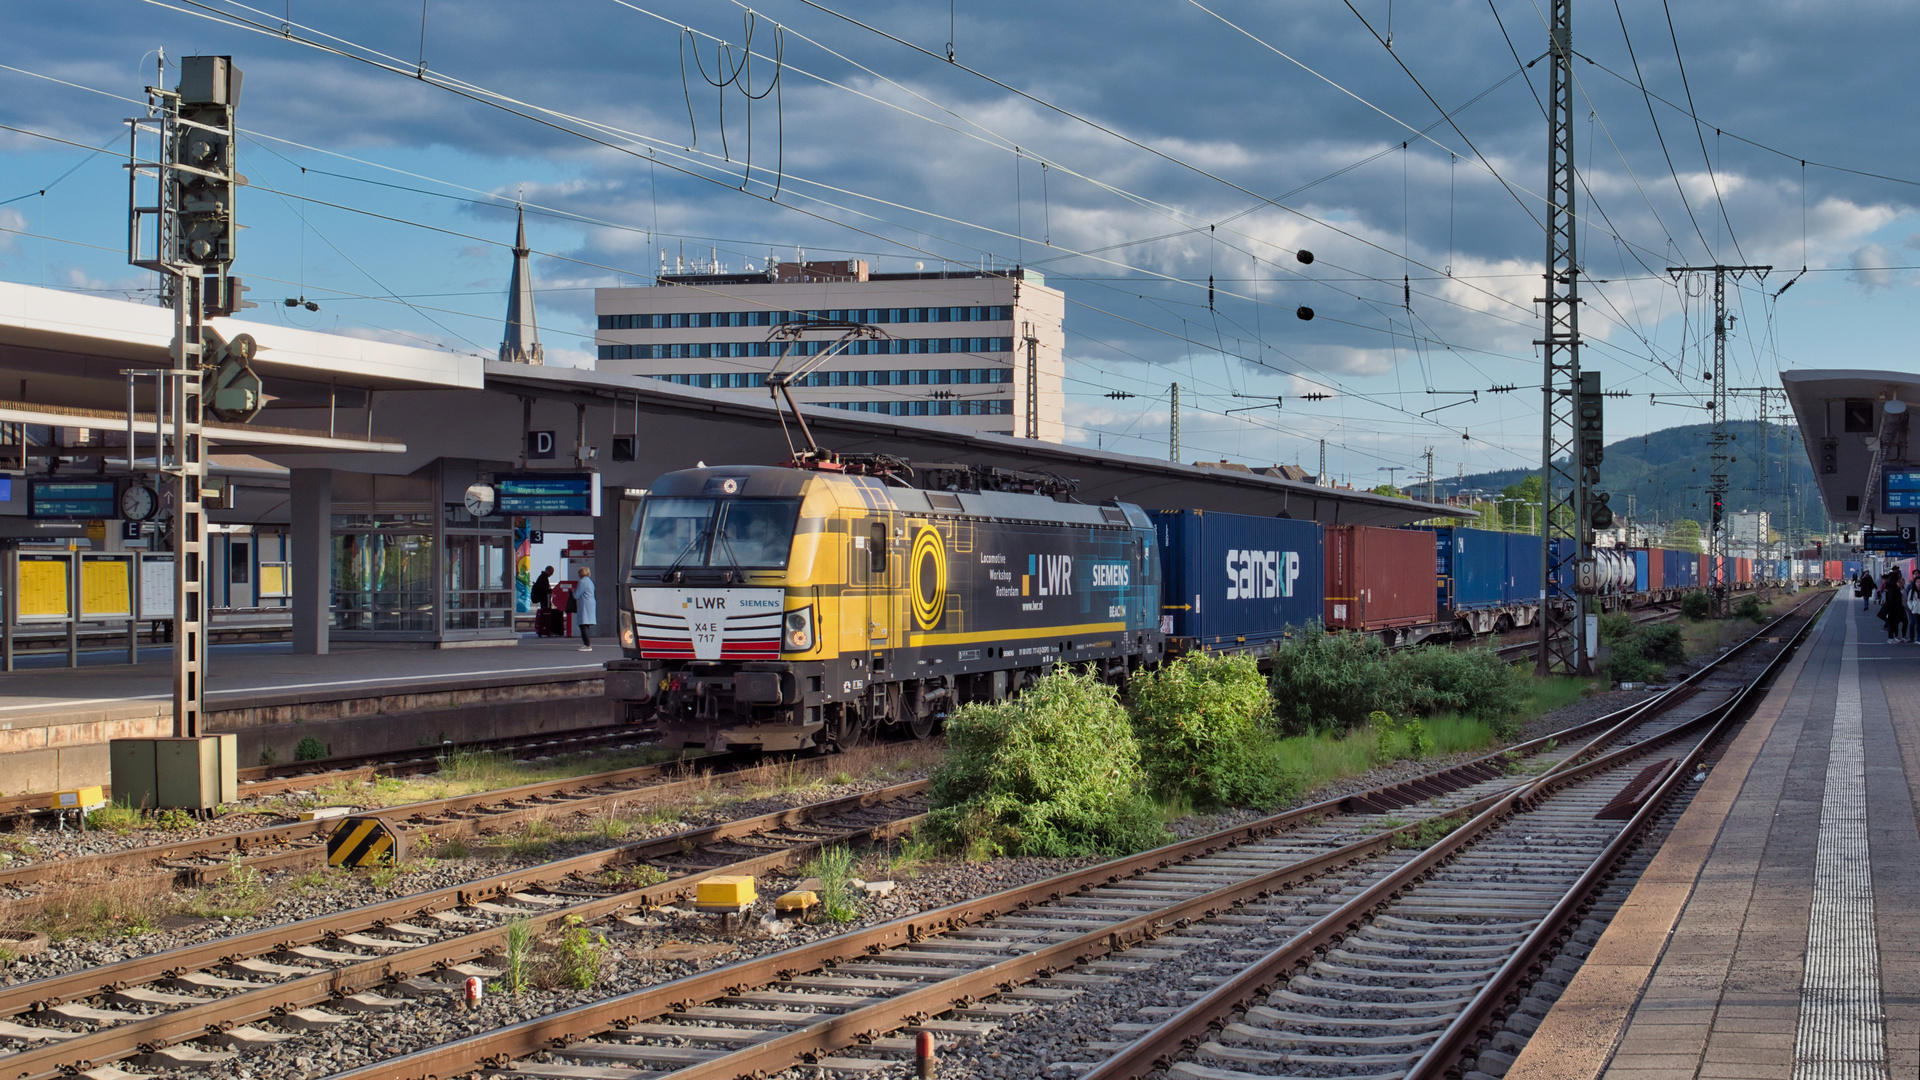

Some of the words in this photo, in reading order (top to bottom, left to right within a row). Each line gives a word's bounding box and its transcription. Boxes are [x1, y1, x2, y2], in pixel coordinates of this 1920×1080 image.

[537, 432, 552, 453] D
[129, 522, 137, 536] E
[1902, 528, 1910, 539] 8
[535, 531, 541, 541] 3
[980, 552, 1006, 564] Locomotive
[990, 569, 1011, 582] Workshop
[1038, 554, 1072, 596] LWR
[1092, 564, 1128, 586] SIEMENS
[996, 586, 1019, 596] Rotterdam
[696, 597, 726, 609] LWR
[1022, 601, 1043, 611] www.lwr.nl
[695, 623, 707, 632] X4
[711, 623, 717, 632] E
[698, 634, 715, 642] 717
